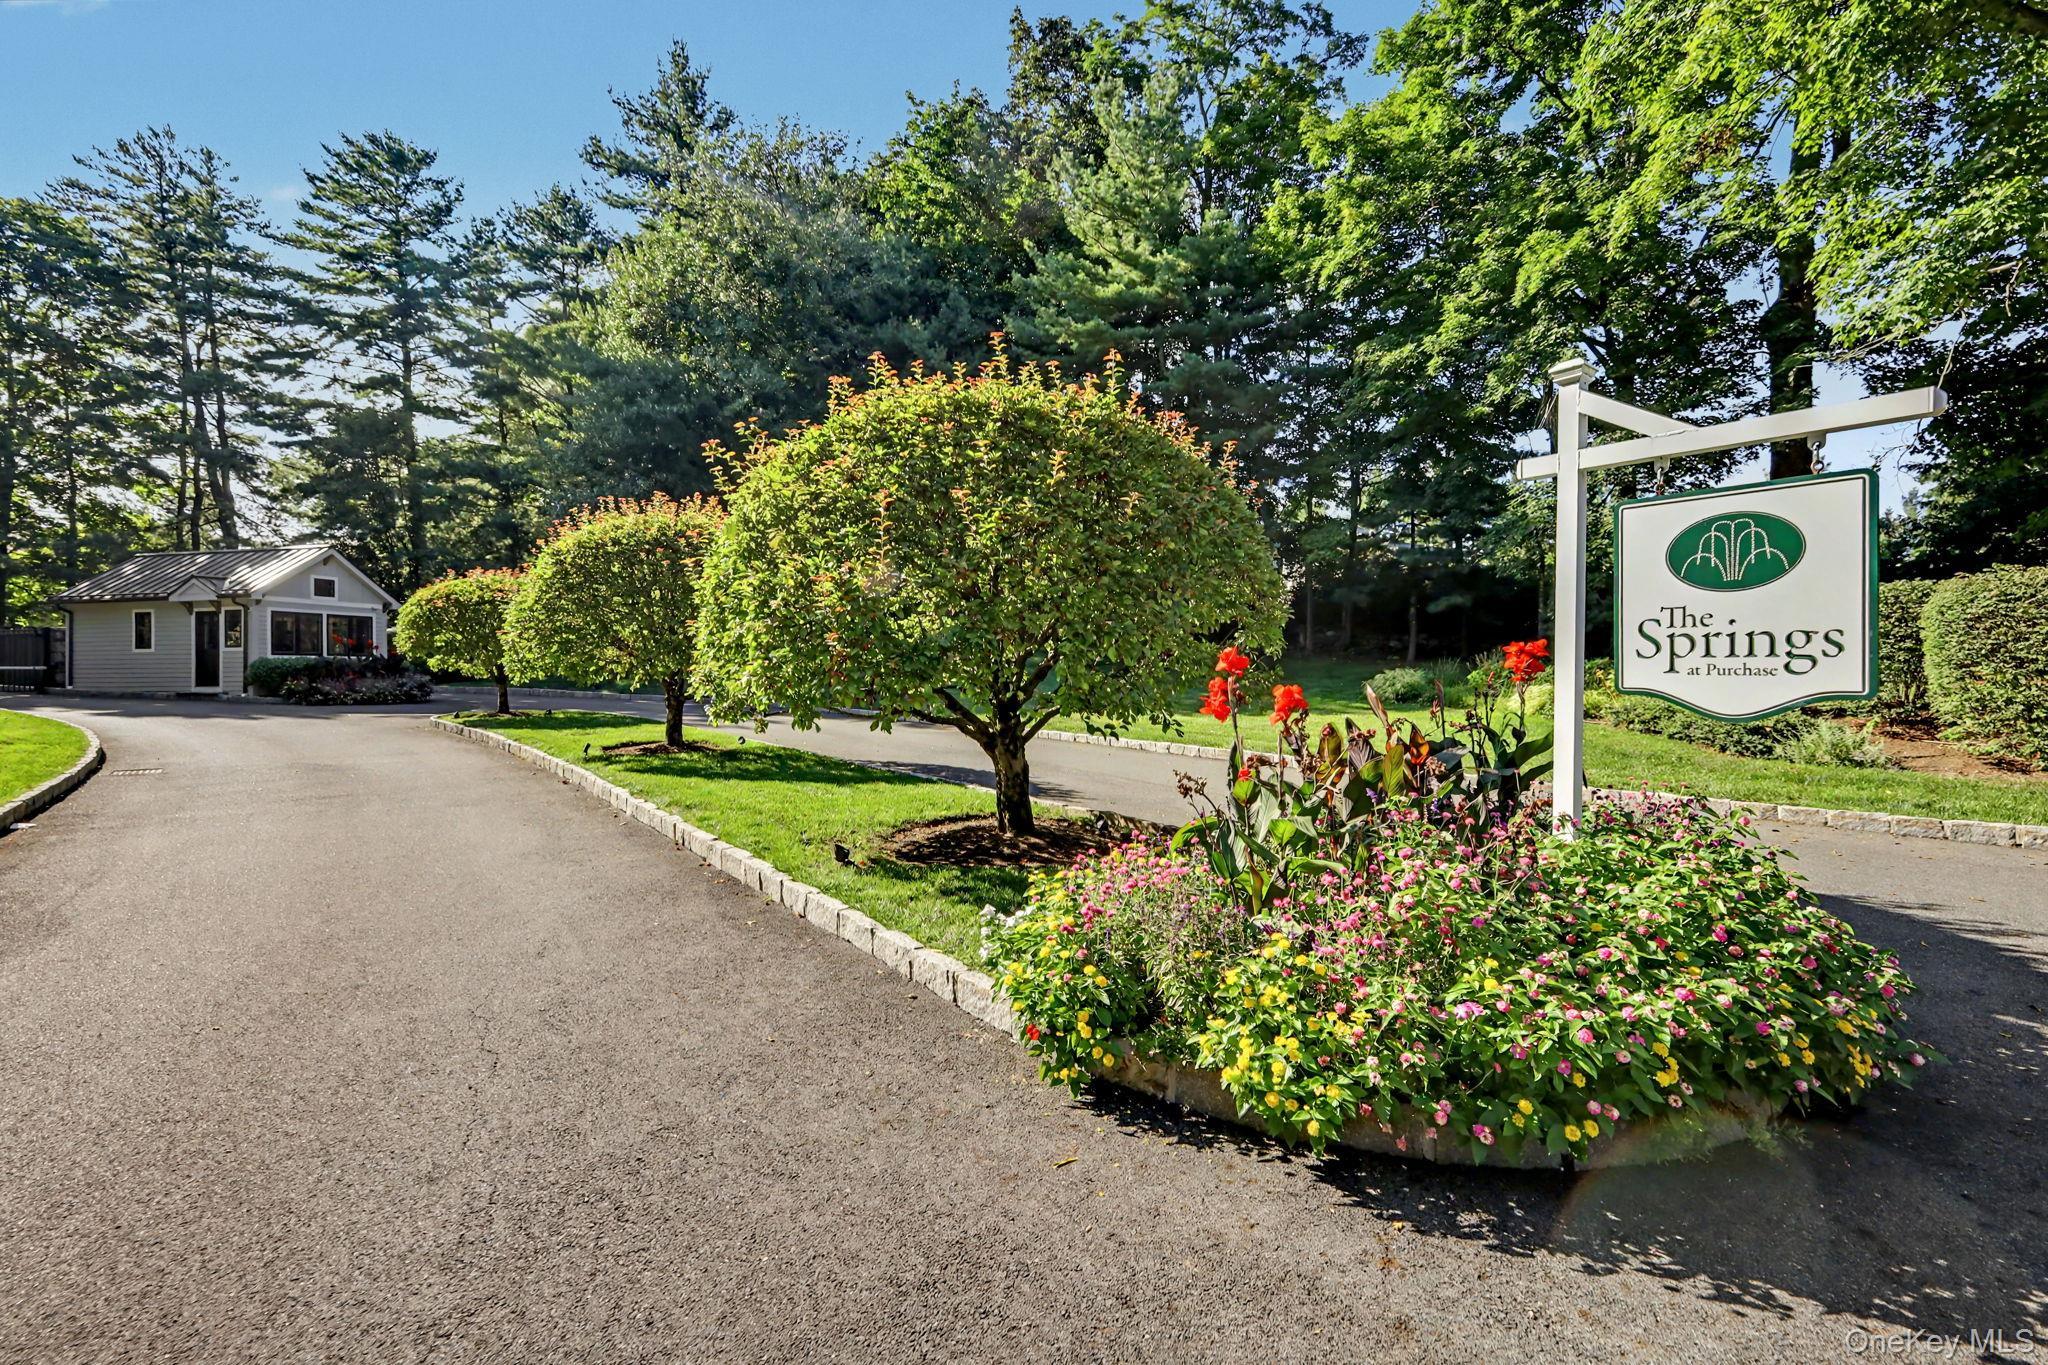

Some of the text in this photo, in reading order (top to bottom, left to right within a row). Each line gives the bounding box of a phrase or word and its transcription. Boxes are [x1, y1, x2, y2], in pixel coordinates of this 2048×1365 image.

[1660, 605, 1714, 629] The
[1635, 618, 1845, 675] Springs
[1686, 663, 1778, 677] at Purchase
